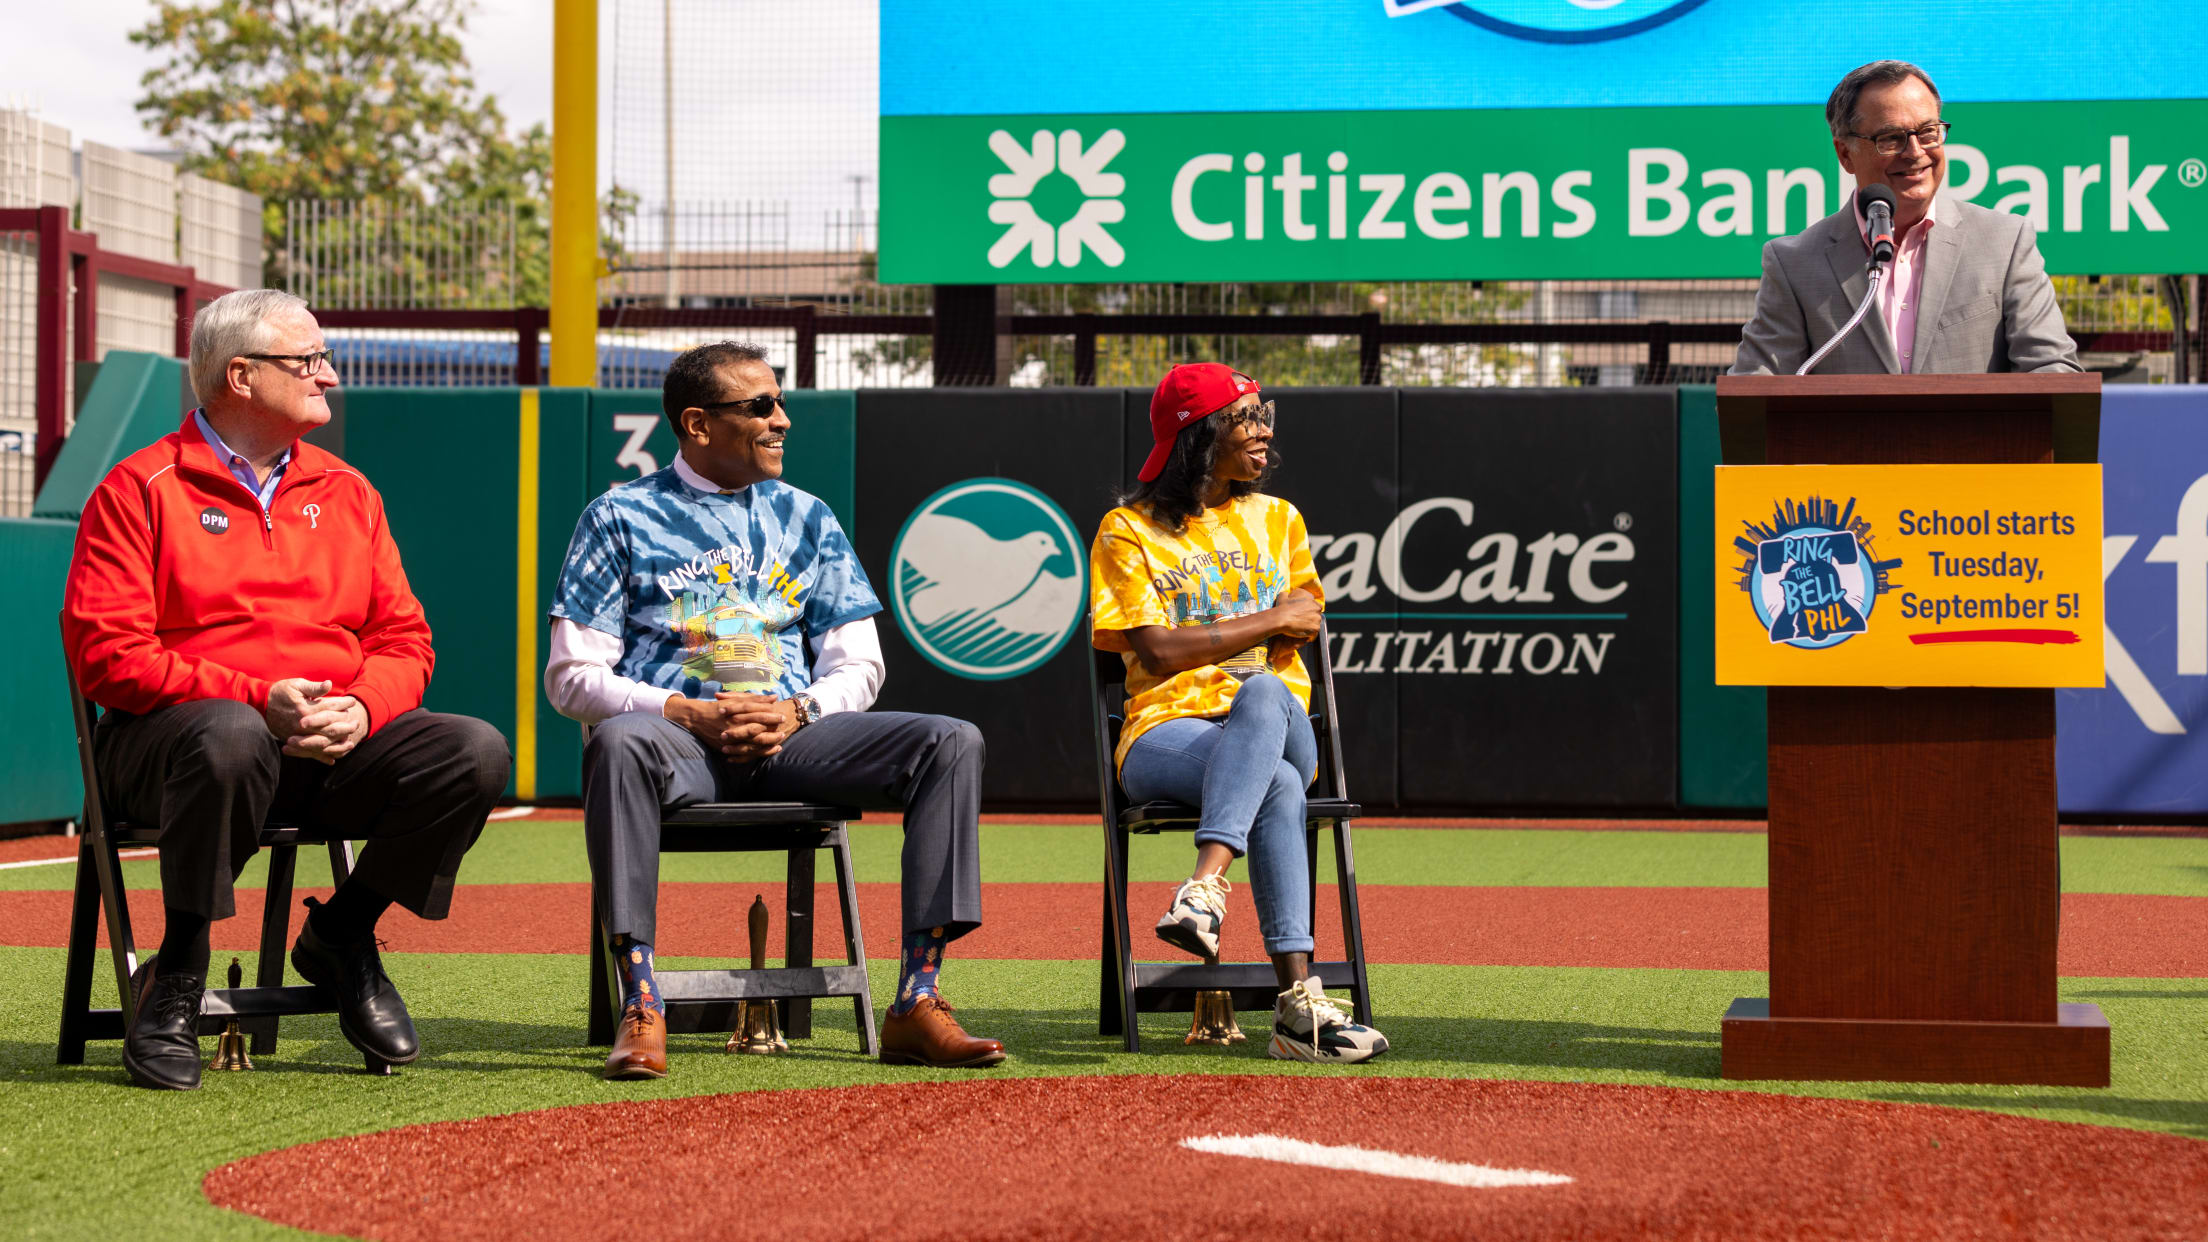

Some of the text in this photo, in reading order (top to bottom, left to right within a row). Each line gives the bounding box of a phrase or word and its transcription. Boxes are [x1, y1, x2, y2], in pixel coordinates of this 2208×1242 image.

[1171, 150, 1597, 241] Citizens
[202, 513, 228, 528] DPM
[1898, 509, 2076, 536] School starts
[1783, 537, 1833, 564] RING
[657, 545, 804, 608] RING THE BELL PHL
[1153, 557, 1200, 601] RING
[1192, 551, 1218, 568] THE
[1214, 550, 1266, 575] BELL
[1791, 566, 1814, 581] THE
[1928, 551, 2044, 584] Tuesday,
[1781, 574, 1847, 616] BELL
[1901, 592, 2080, 625] September 5!
[1804, 603, 1852, 636] PHL
